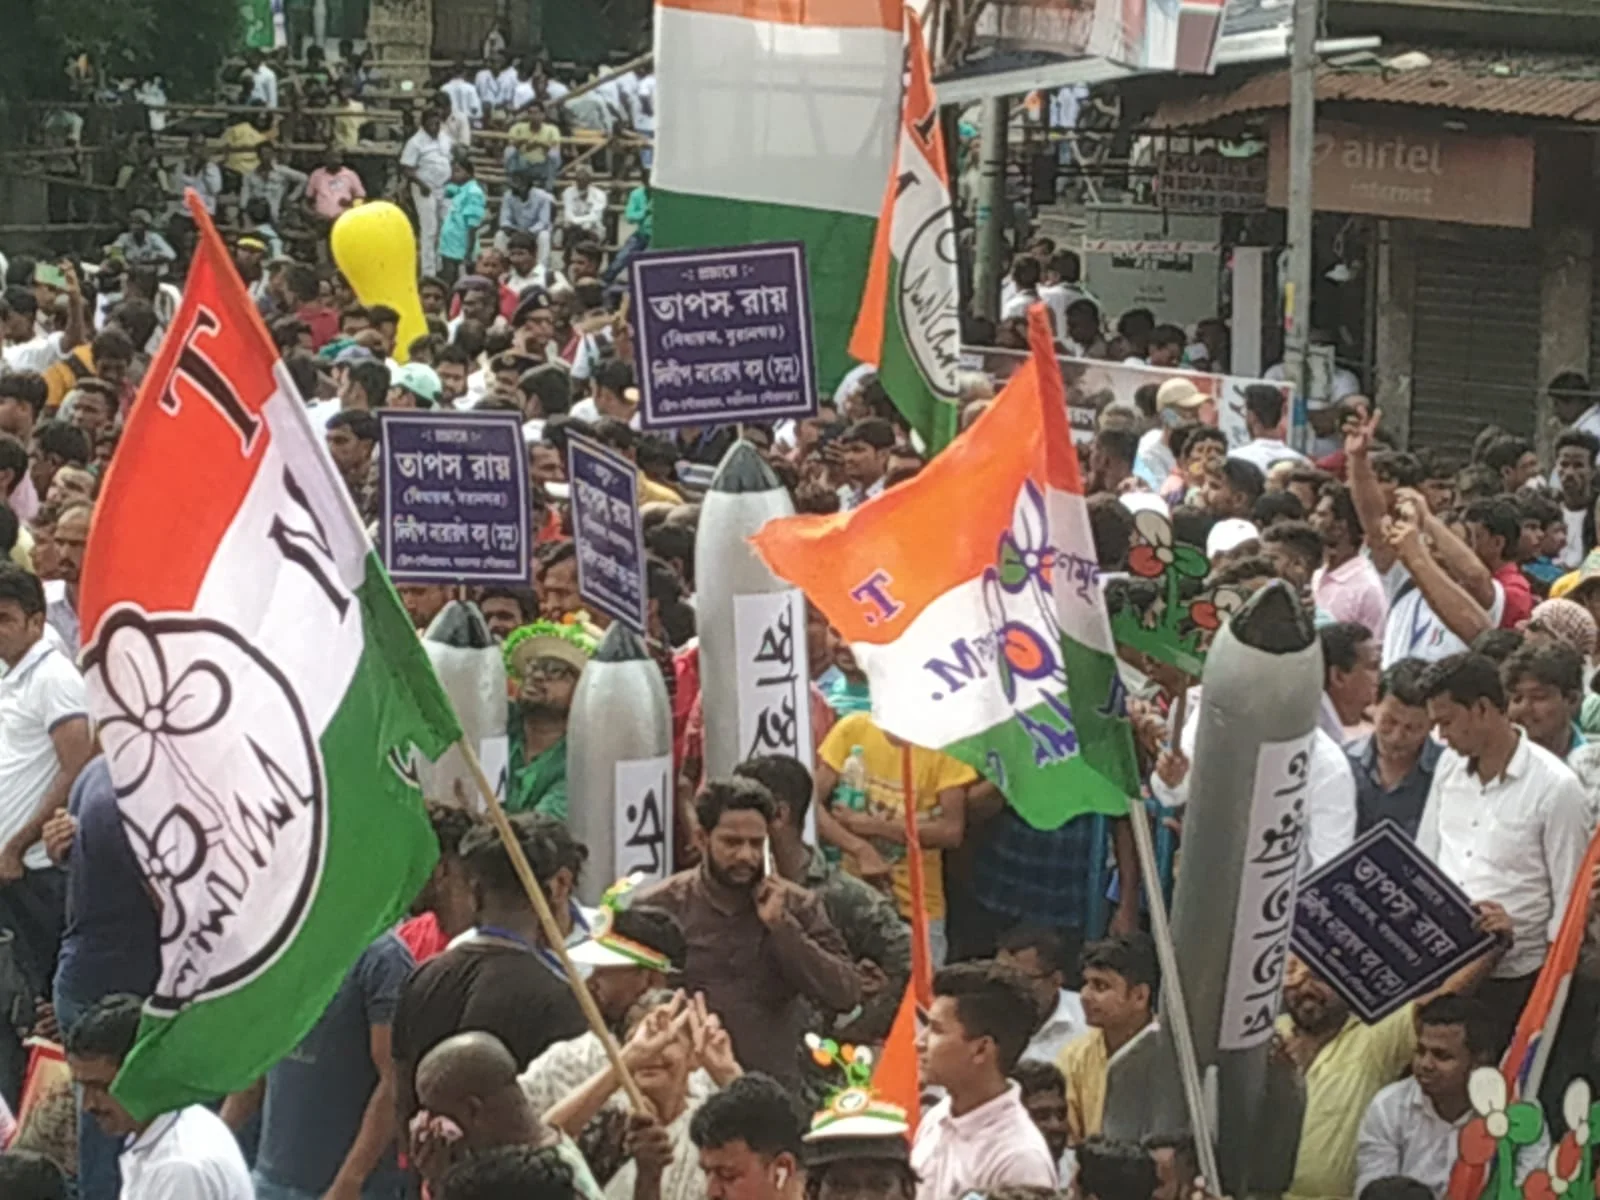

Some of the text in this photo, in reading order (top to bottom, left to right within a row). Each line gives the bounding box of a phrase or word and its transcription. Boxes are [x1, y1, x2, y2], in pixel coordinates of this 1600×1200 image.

[1341, 134, 1445, 175] airtel
[648, 285, 788, 323] তাপস রায়
[158, 302, 264, 459] T
[395, 451, 511, 482] তাপস রায়
[1353, 855, 1458, 958] তাপস রায়
